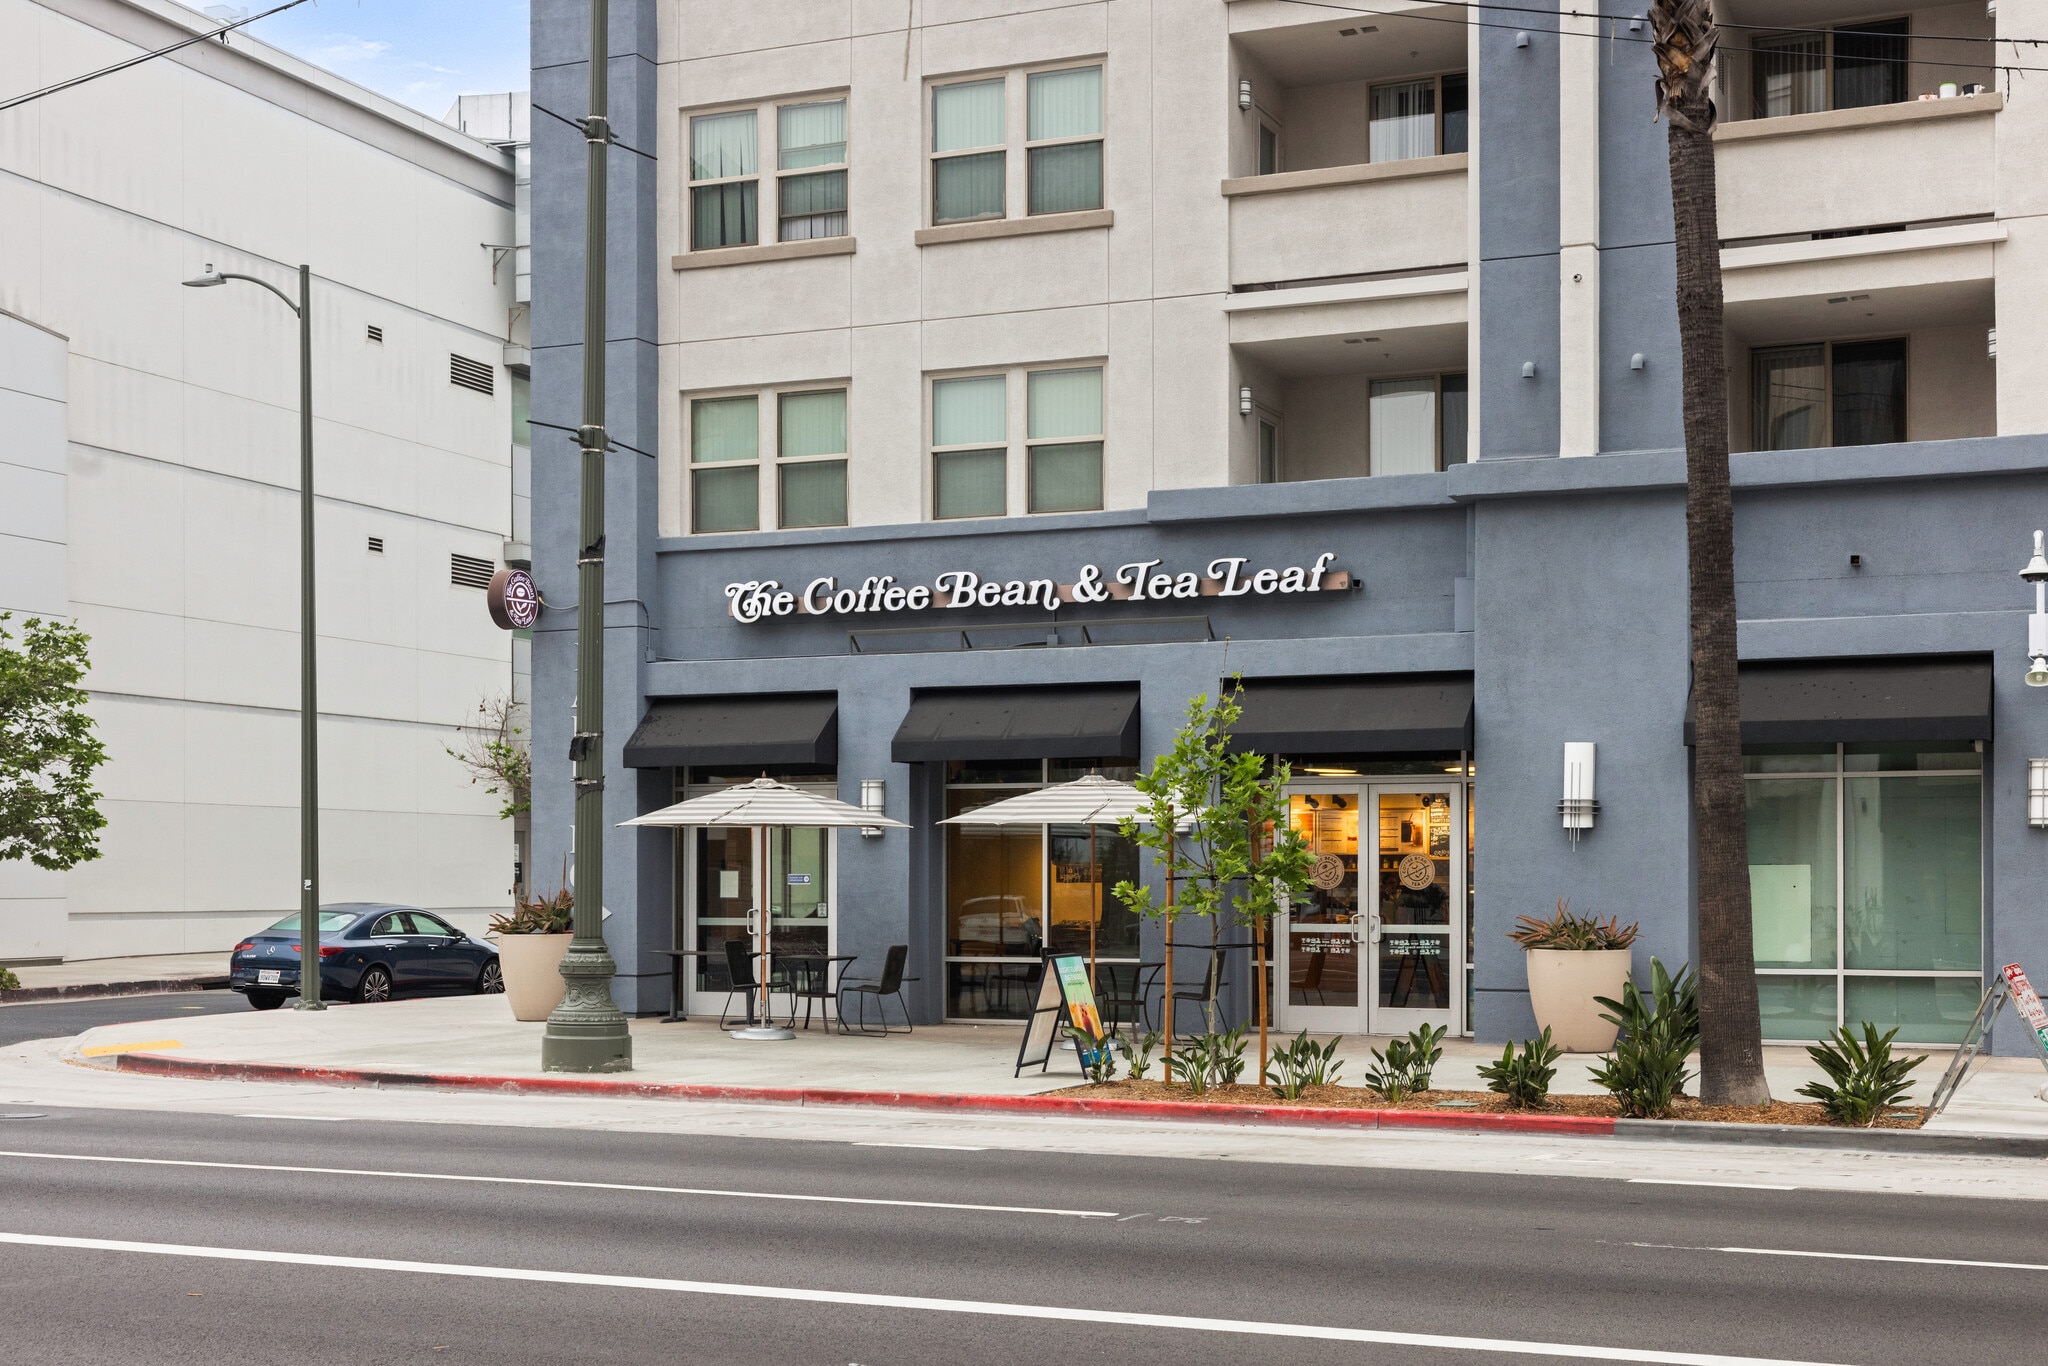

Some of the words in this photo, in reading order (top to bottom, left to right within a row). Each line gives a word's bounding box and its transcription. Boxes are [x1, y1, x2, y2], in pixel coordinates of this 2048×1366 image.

[511, 574, 525, 585] Coffee
[525, 577, 535, 600] Bean
[724, 580, 794, 623] The
[803, 575, 930, 615] Coffee
[935, 571, 1060, 611] Bean
[1071, 564, 1109, 603] &
[1116, 559, 1199, 601] Tea
[1207, 552, 1334, 596] Leaf
[513, 614, 522, 625] Tea
[522, 611, 534, 625] Leaf
[1324, 856, 1337, 864] BEAN
[1330, 874, 1339, 885] LEAF
[1421, 874, 1430, 885] LEAF
